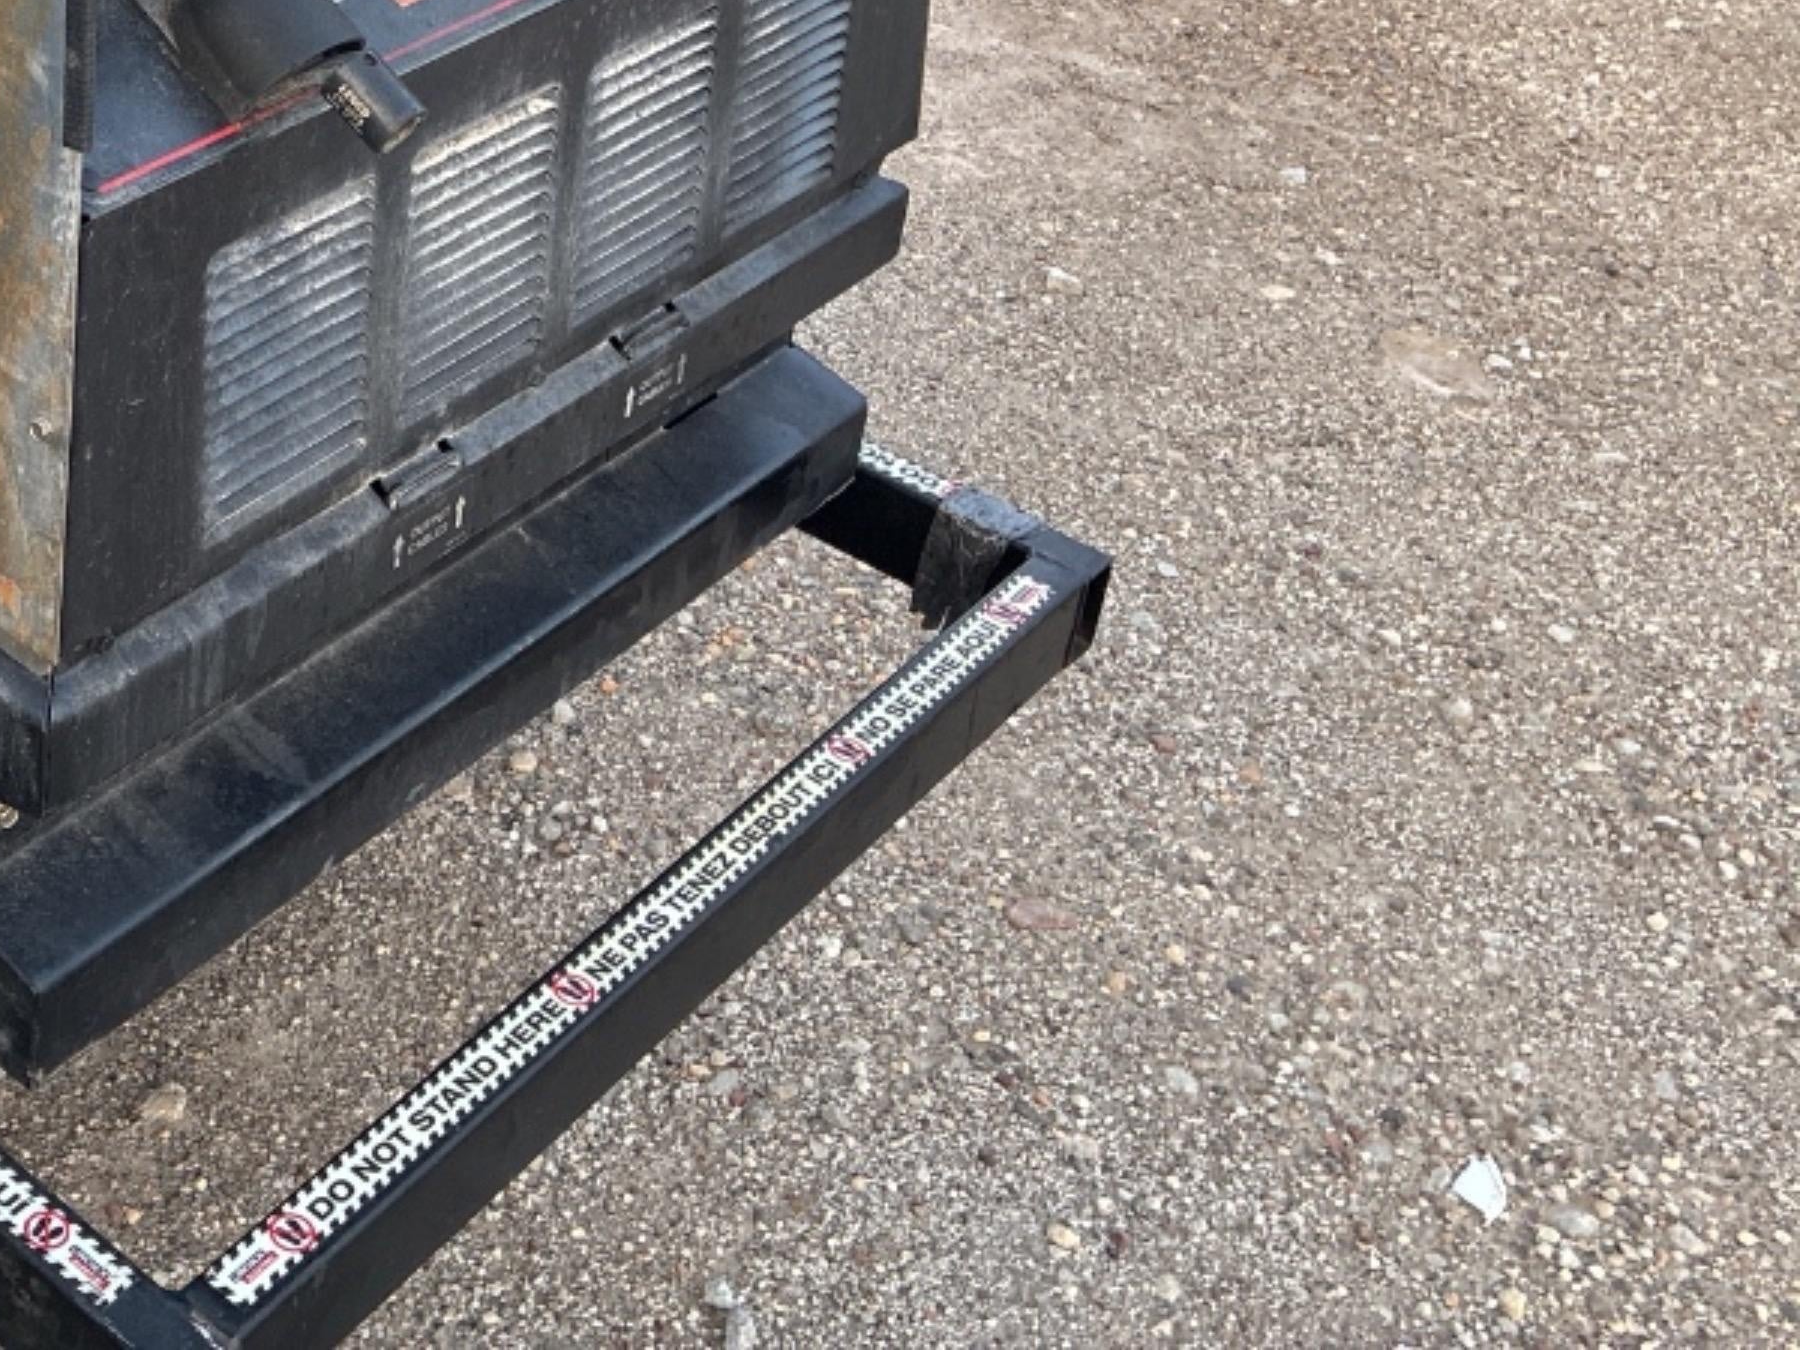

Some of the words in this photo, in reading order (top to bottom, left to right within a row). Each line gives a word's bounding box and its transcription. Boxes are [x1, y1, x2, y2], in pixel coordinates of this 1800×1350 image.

[859, 715, 893, 746] NO
[888, 690, 919, 723] SE
[910, 646, 960, 696] PARE
[954, 620, 1000, 656] AQUI
[586, 949, 626, 983] NE
[619, 910, 670, 956] PAS
[665, 855, 735, 921] TENEZ
[729, 781, 815, 855] DEBOUT
[808, 756, 840, 790] ICI
[307, 1178, 355, 1222] DO
[350, 1129, 417, 1179] NOT
[408, 1053, 498, 1135] STAND
[493, 997, 568, 1061] HERE
